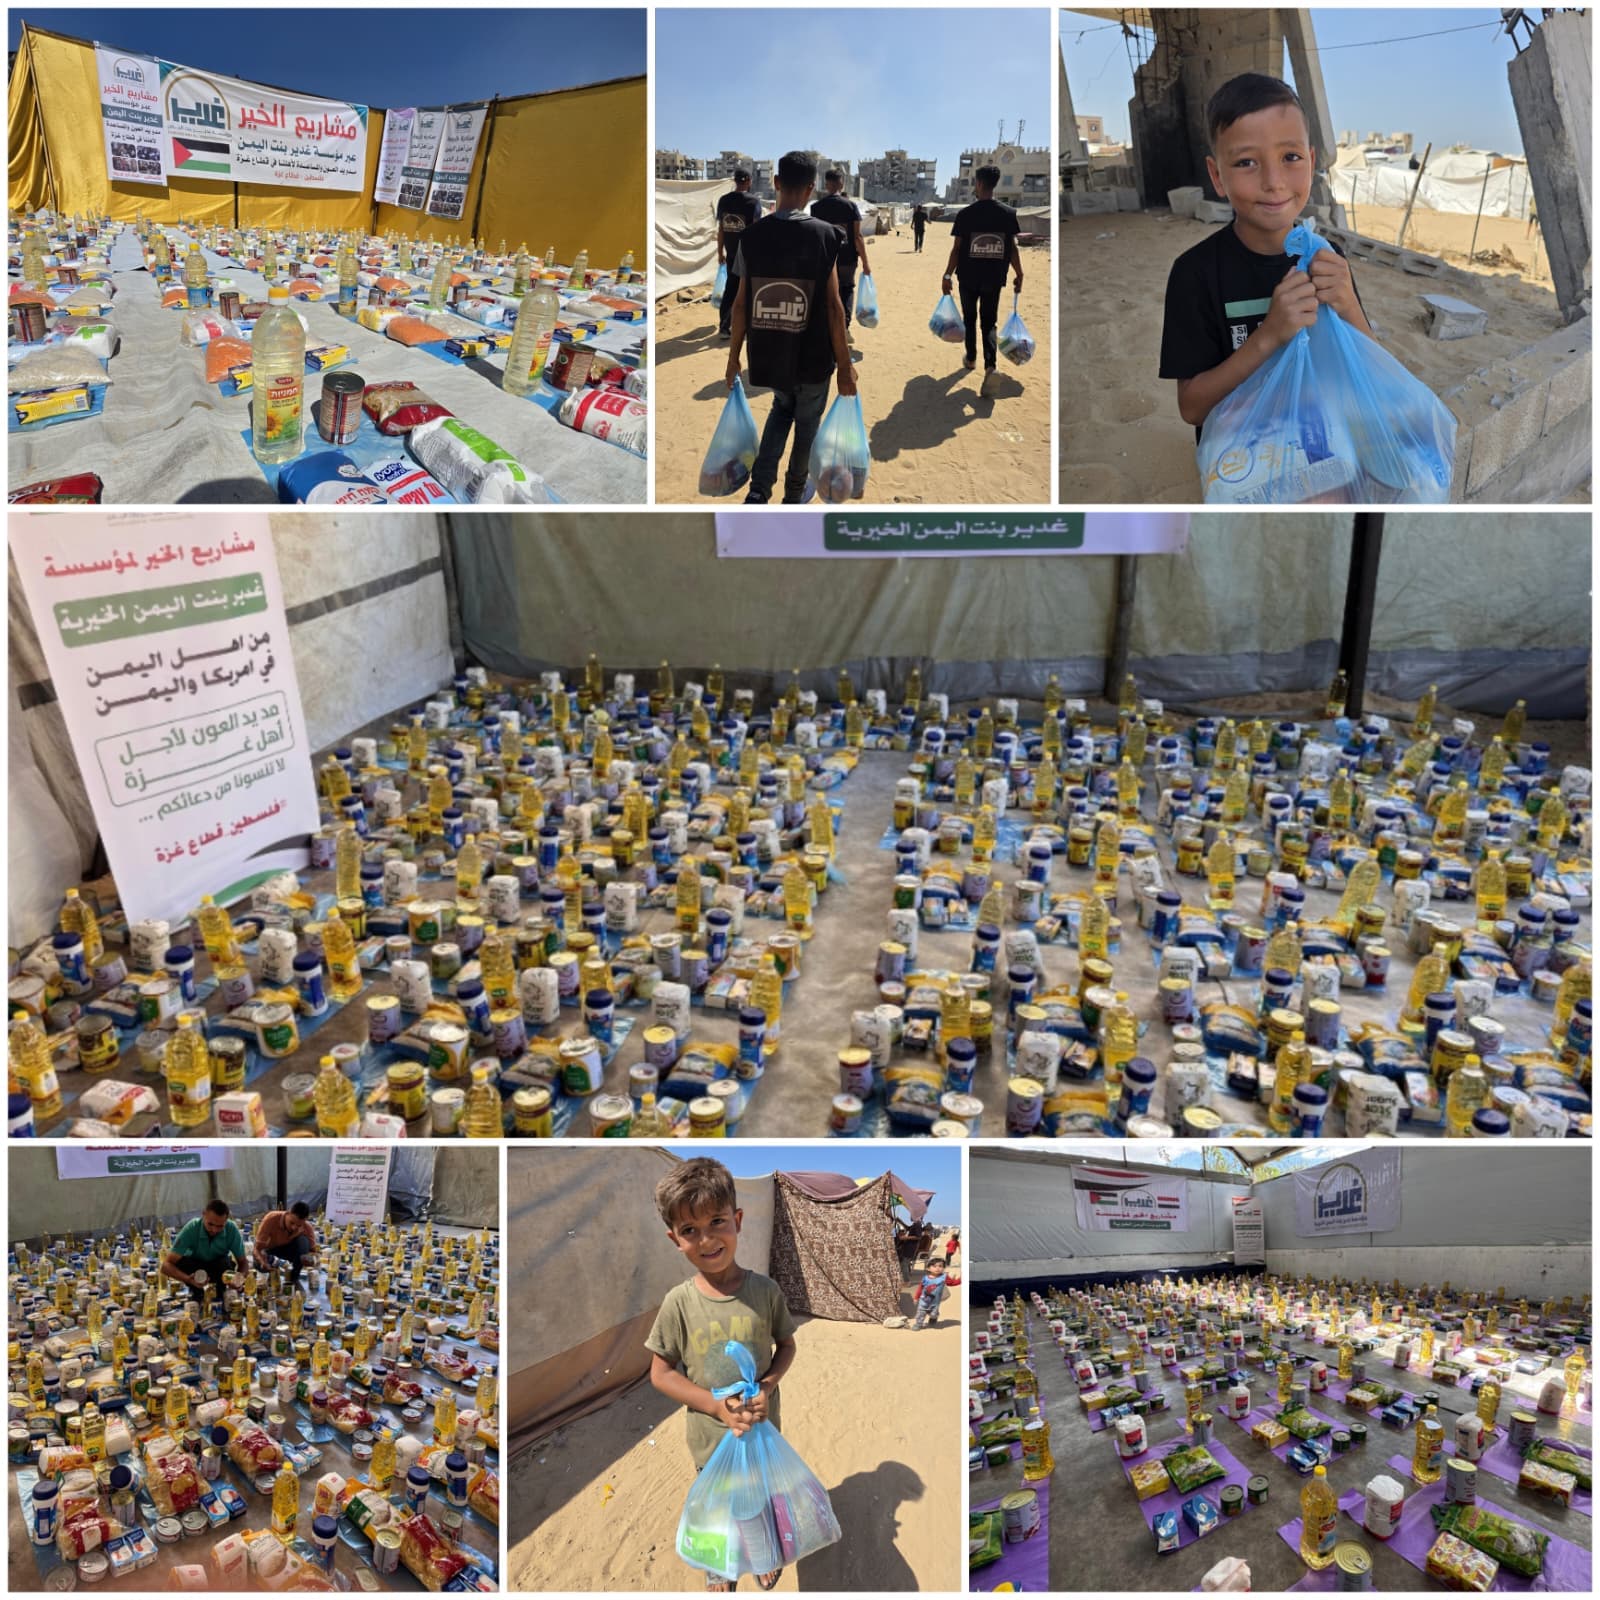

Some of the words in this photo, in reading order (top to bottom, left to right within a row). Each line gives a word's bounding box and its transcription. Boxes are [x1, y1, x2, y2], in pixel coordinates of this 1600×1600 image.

[237, 102, 286, 129] الخير
[295, 111, 357, 140] مشاريع
[237, 136, 268, 153] اليمن
[271, 140, 288, 156] بنت
[290, 144, 312, 157] غدير
[837, 520, 911, 541] الخيرية
[914, 521, 966, 540] اليمن
[969, 521, 1006, 539] بنت
[1008, 518, 1069, 538] غدير
[145, 544, 184, 570] الخير
[191, 532, 255, 567] مشاريع
[45, 549, 139, 578] لمؤسسة
[193, 589, 228, 609] بنت
[232, 579, 264, 606] غدير
[60, 602, 127, 634] الخيرية
[132, 595, 187, 623] اليمن
[248, 631, 271, 651] من
[86, 651, 163, 688] اليمن
[202, 659, 255, 687] امريكا
[259, 649, 276, 683] في
[95, 675, 199, 717] واليمن
[242, 709, 258, 728] يد
[260, 703, 280, 719] مد
[192, 712, 239, 746] العون
[256, 719, 286, 751] أهل
[119, 726, 187, 766] لأجل
[233, 763, 276, 790] تنسونا
[276, 756, 286, 773] لا
[214, 782, 233, 800] من
[156, 789, 213, 822] دعائكم
[154, 841, 185, 864] غزة
[691, 1315, 767, 1355] GAM
